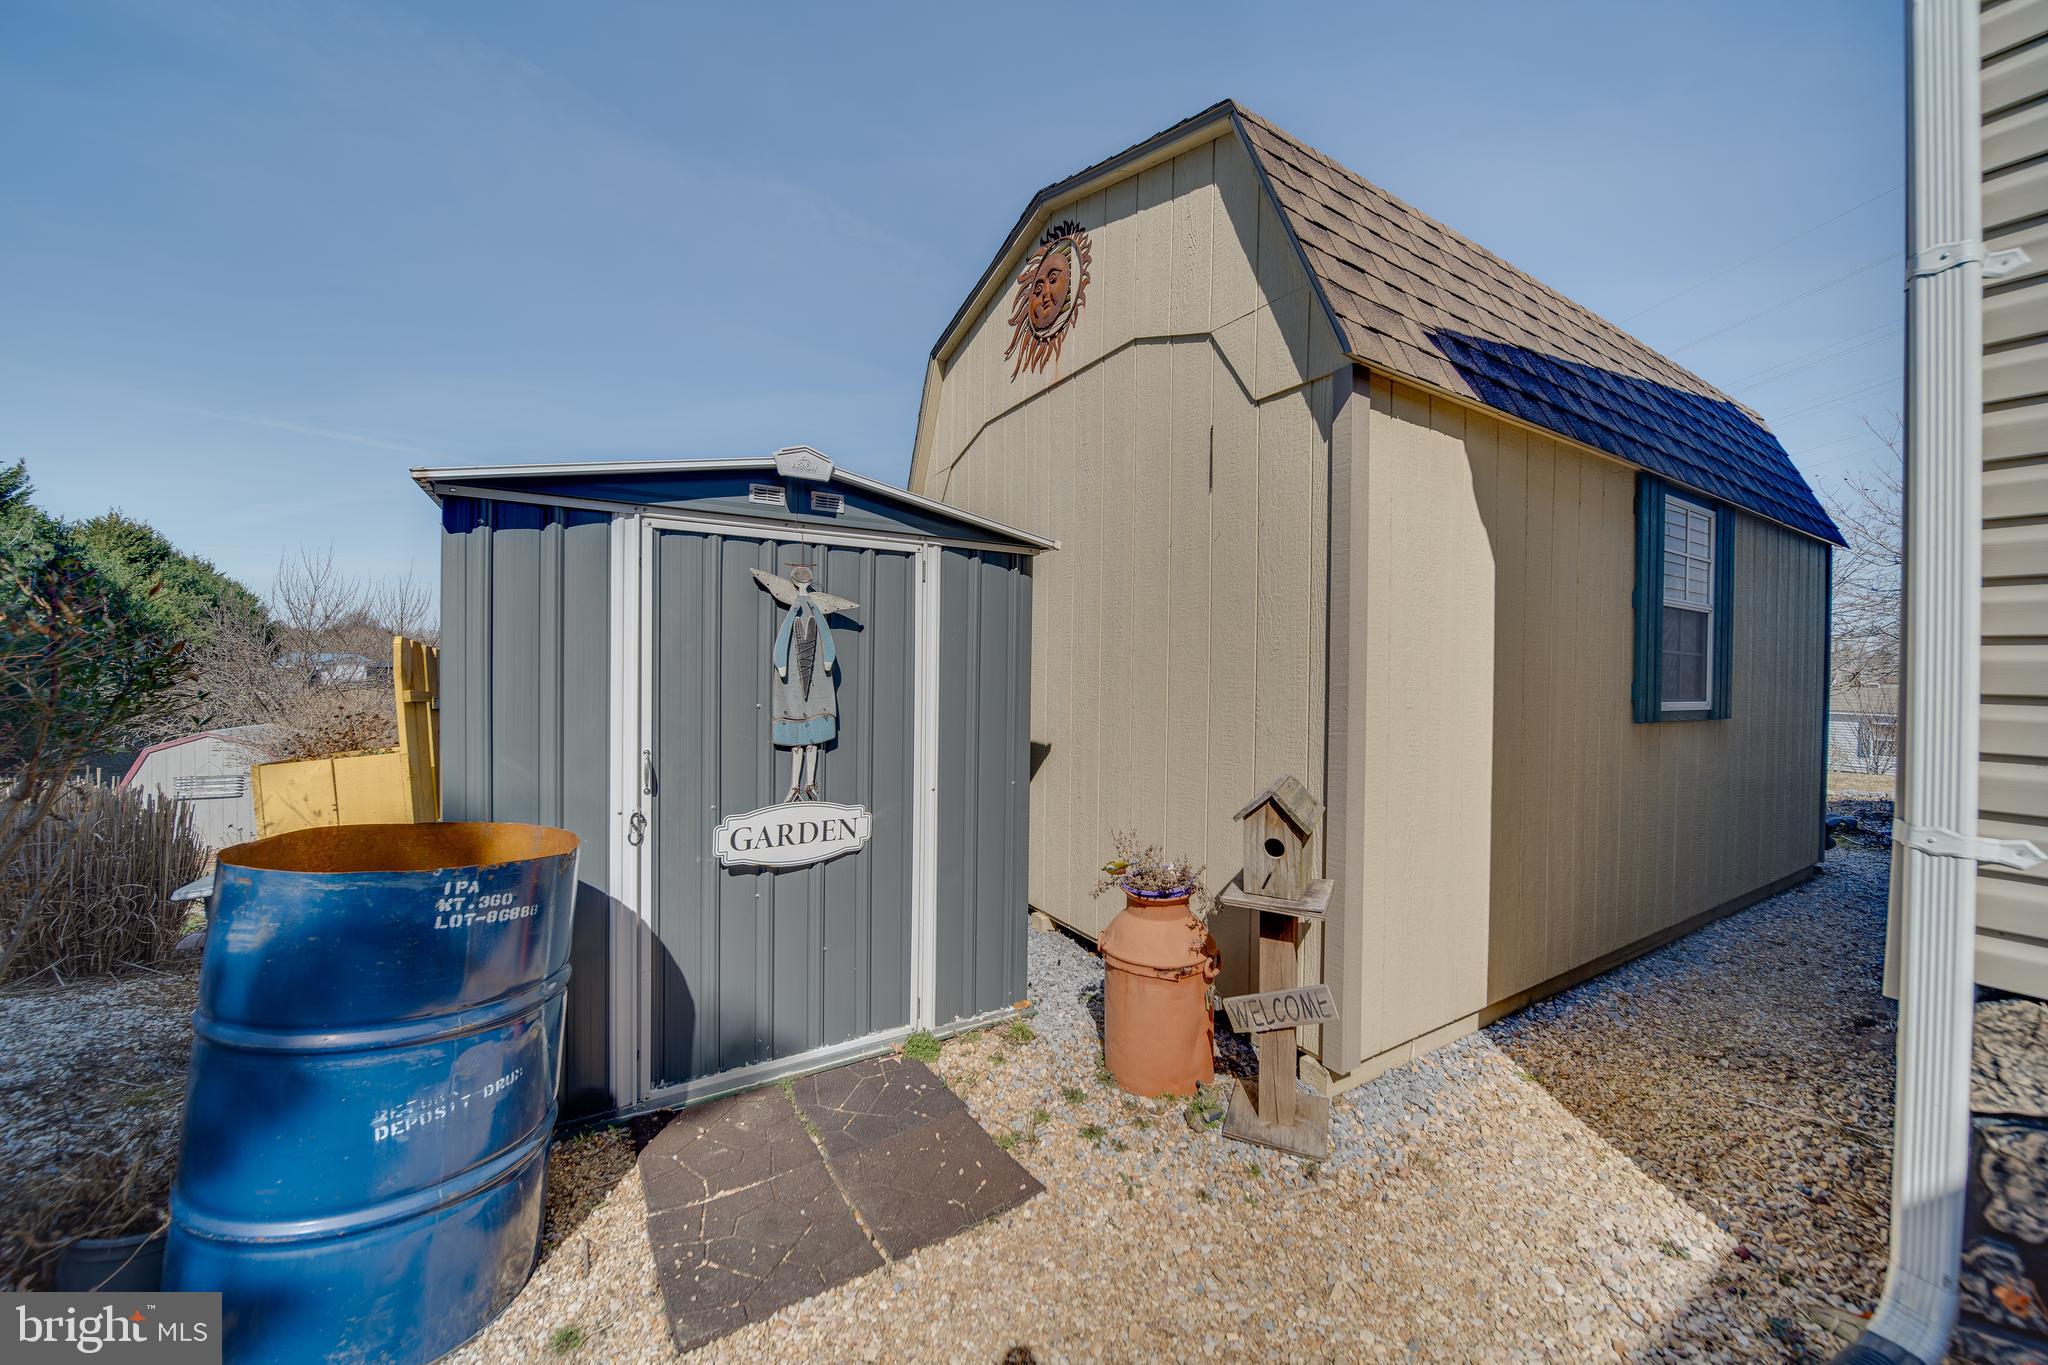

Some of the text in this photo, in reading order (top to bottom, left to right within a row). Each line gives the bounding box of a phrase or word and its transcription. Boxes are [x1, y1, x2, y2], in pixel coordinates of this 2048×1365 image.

[730, 817, 858, 852] GARDEN
[443, 880, 480, 896] IPA
[1228, 991, 1332, 1028] WELCOME
